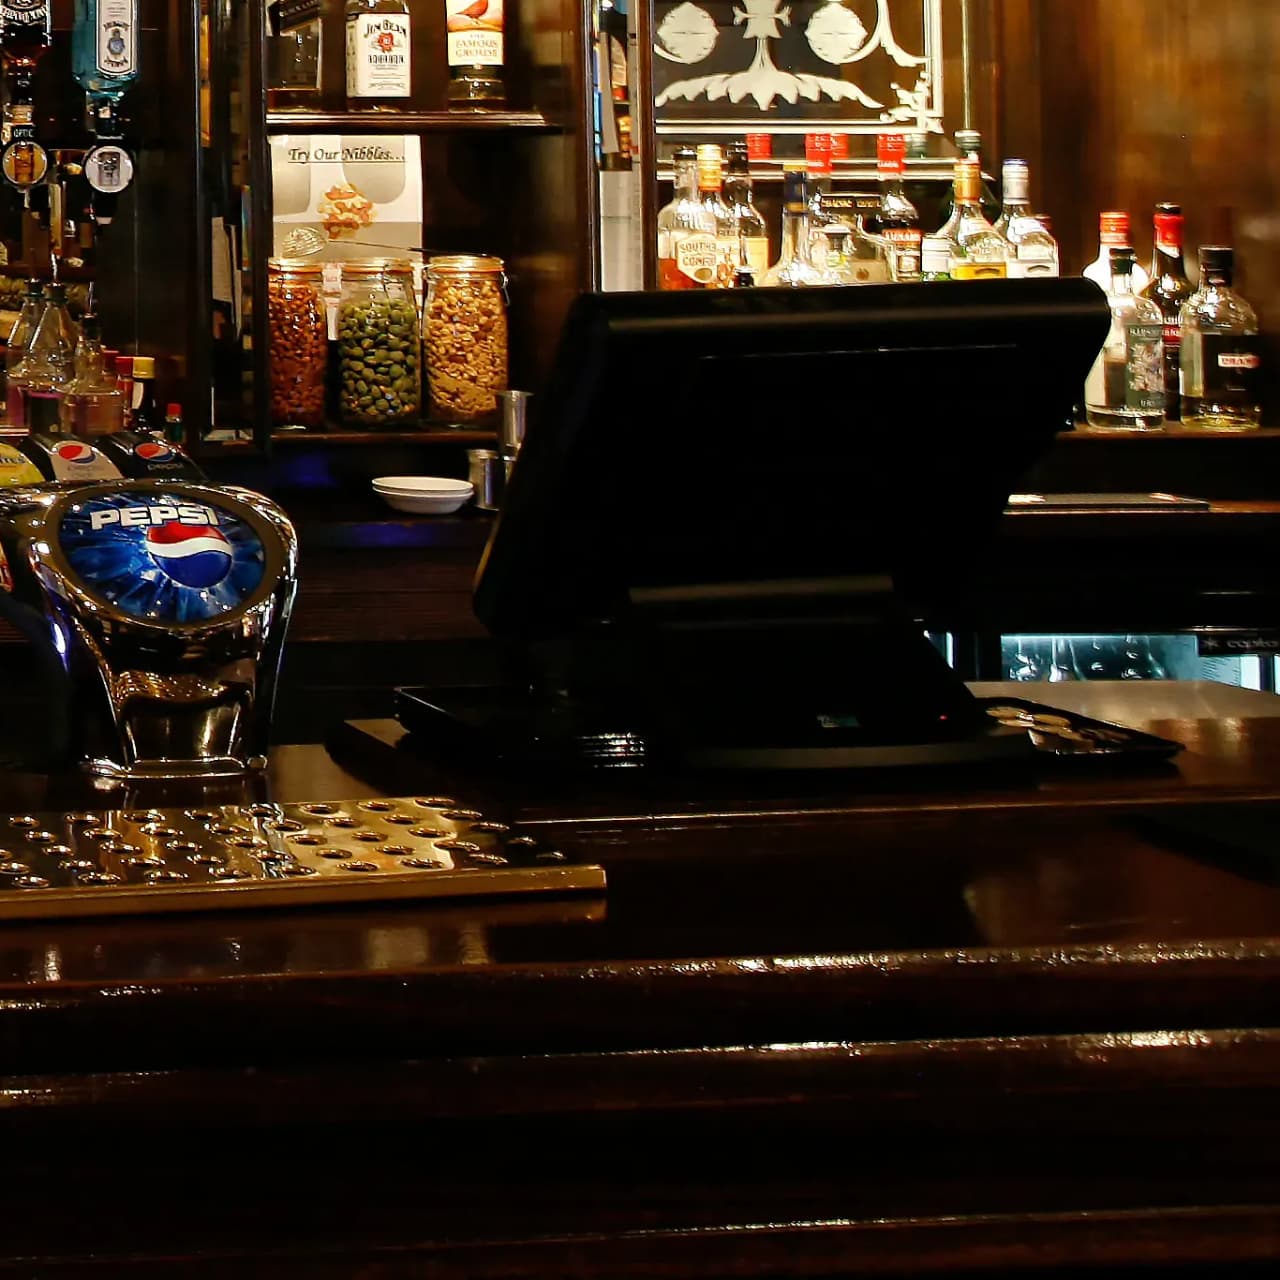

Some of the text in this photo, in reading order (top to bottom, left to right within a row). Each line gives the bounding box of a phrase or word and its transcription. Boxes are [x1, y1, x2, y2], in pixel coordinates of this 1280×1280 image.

[288, 148, 311, 162] Try
[314, 148, 340, 161] Our
[91, 504, 221, 531] PEPSI
